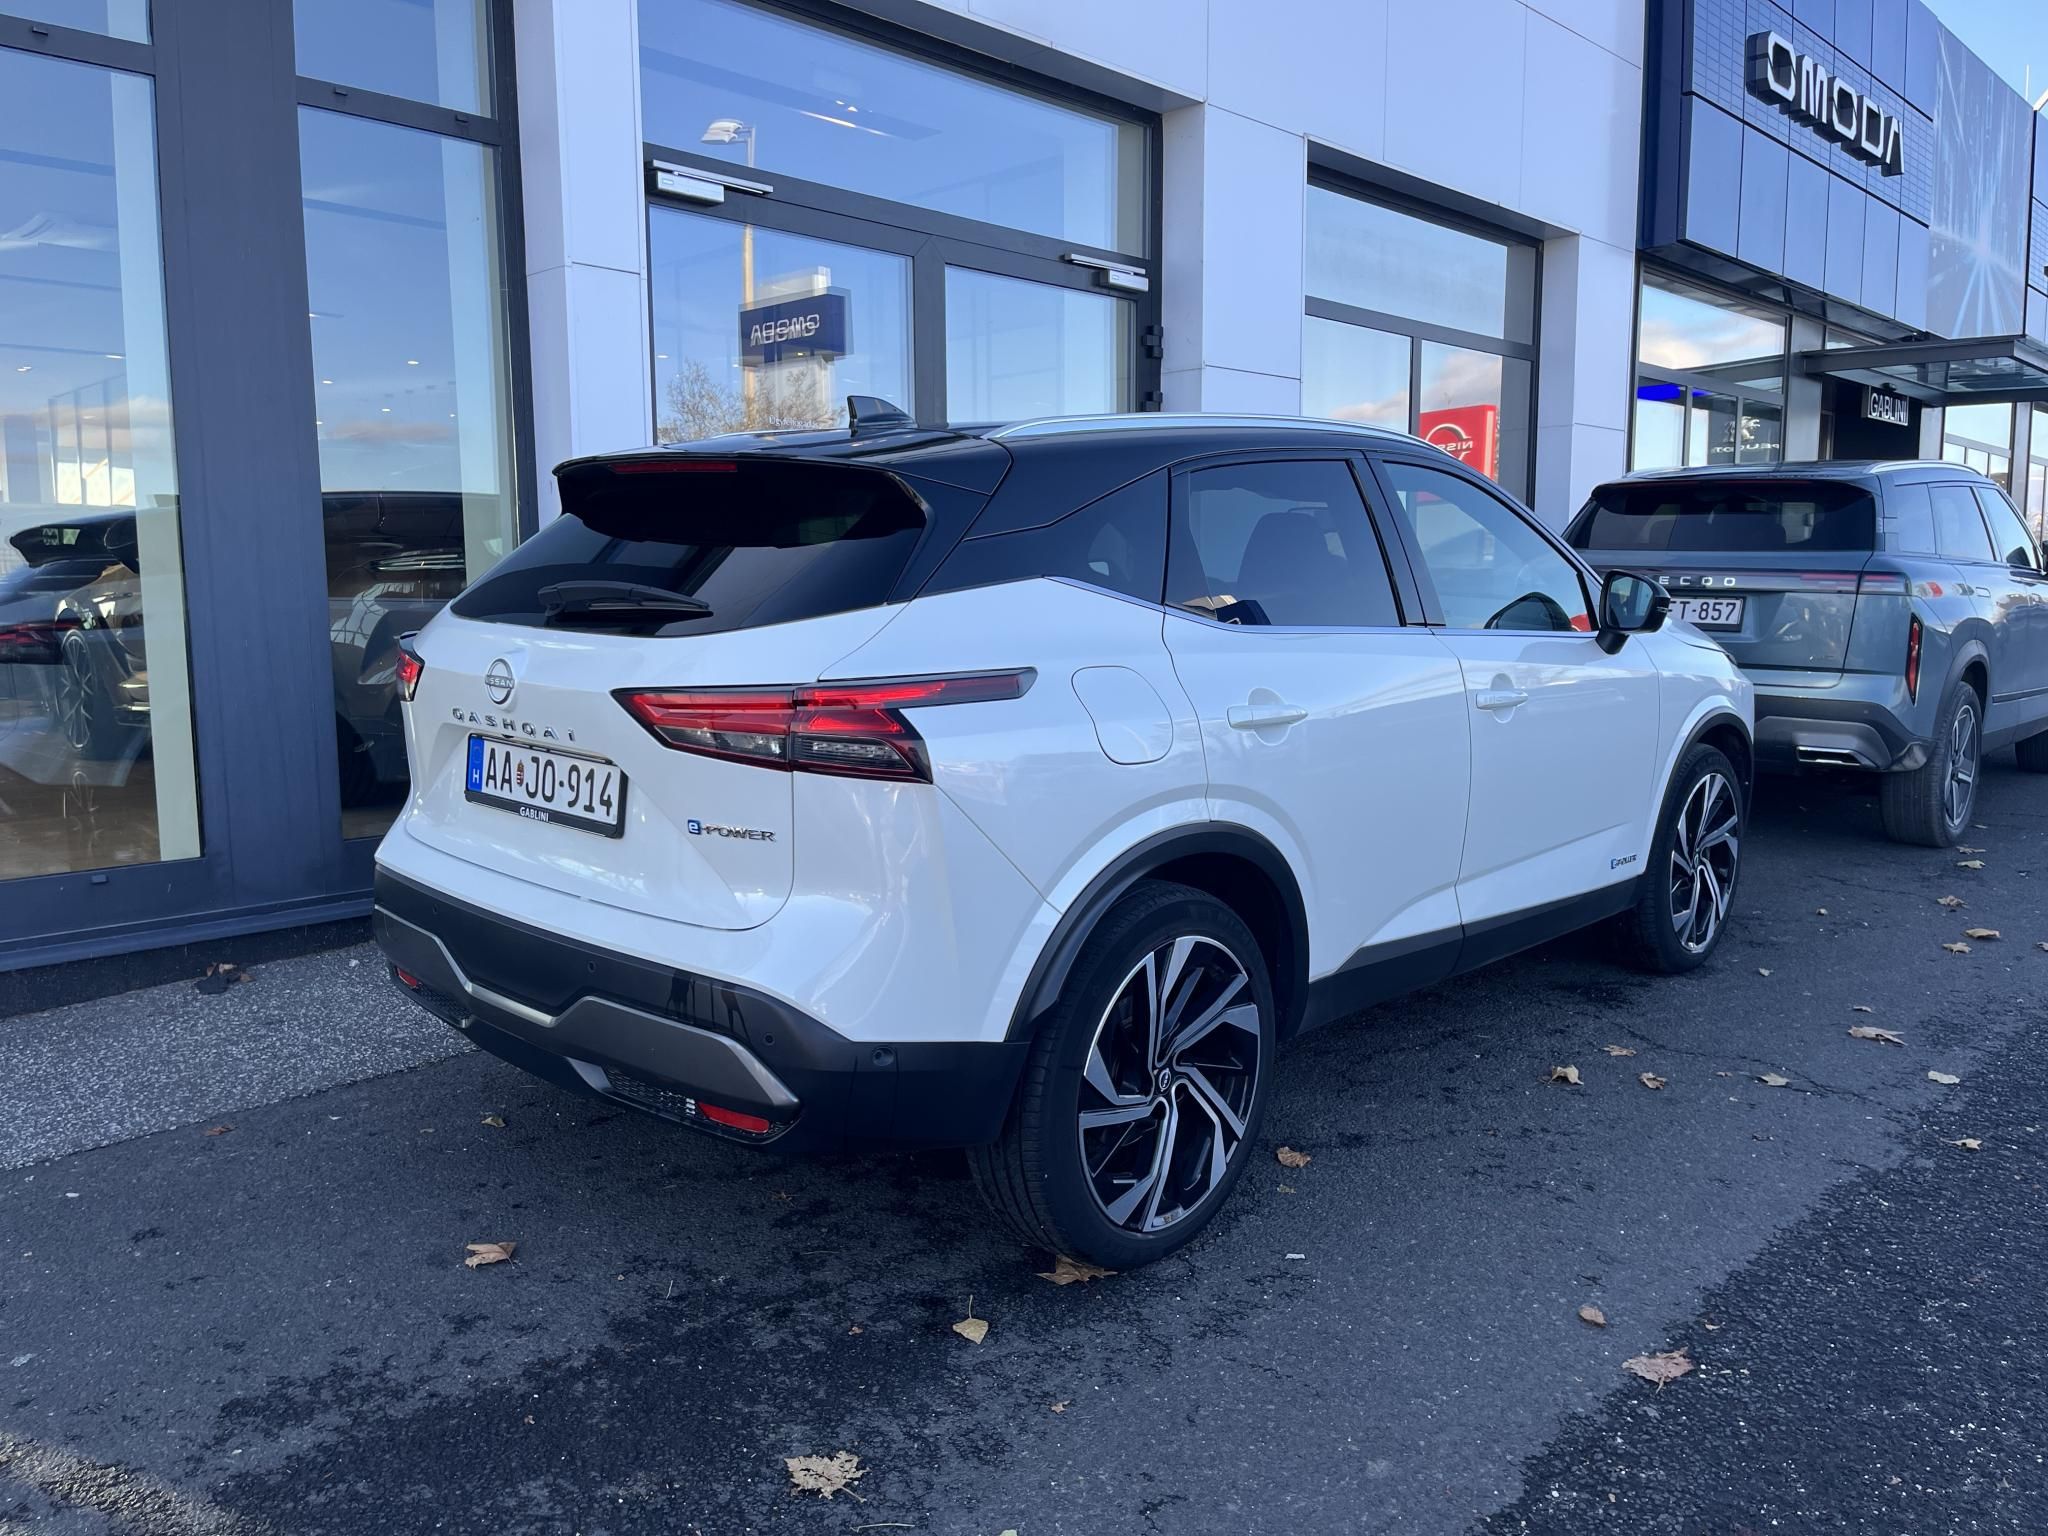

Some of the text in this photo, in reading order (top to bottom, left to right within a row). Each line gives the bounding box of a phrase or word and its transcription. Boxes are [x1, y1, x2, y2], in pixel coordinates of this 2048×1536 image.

[1766, 30, 1904, 174] OMODA
[1871, 392, 1907, 423] GABLINI
[1659, 576, 1736, 586] ECOO
[452, 708, 576, 742] QASHQAI
[472, 769, 480, 784] H
[485, 747, 513, 794] AA
[519, 806, 549, 822] GABLINI
